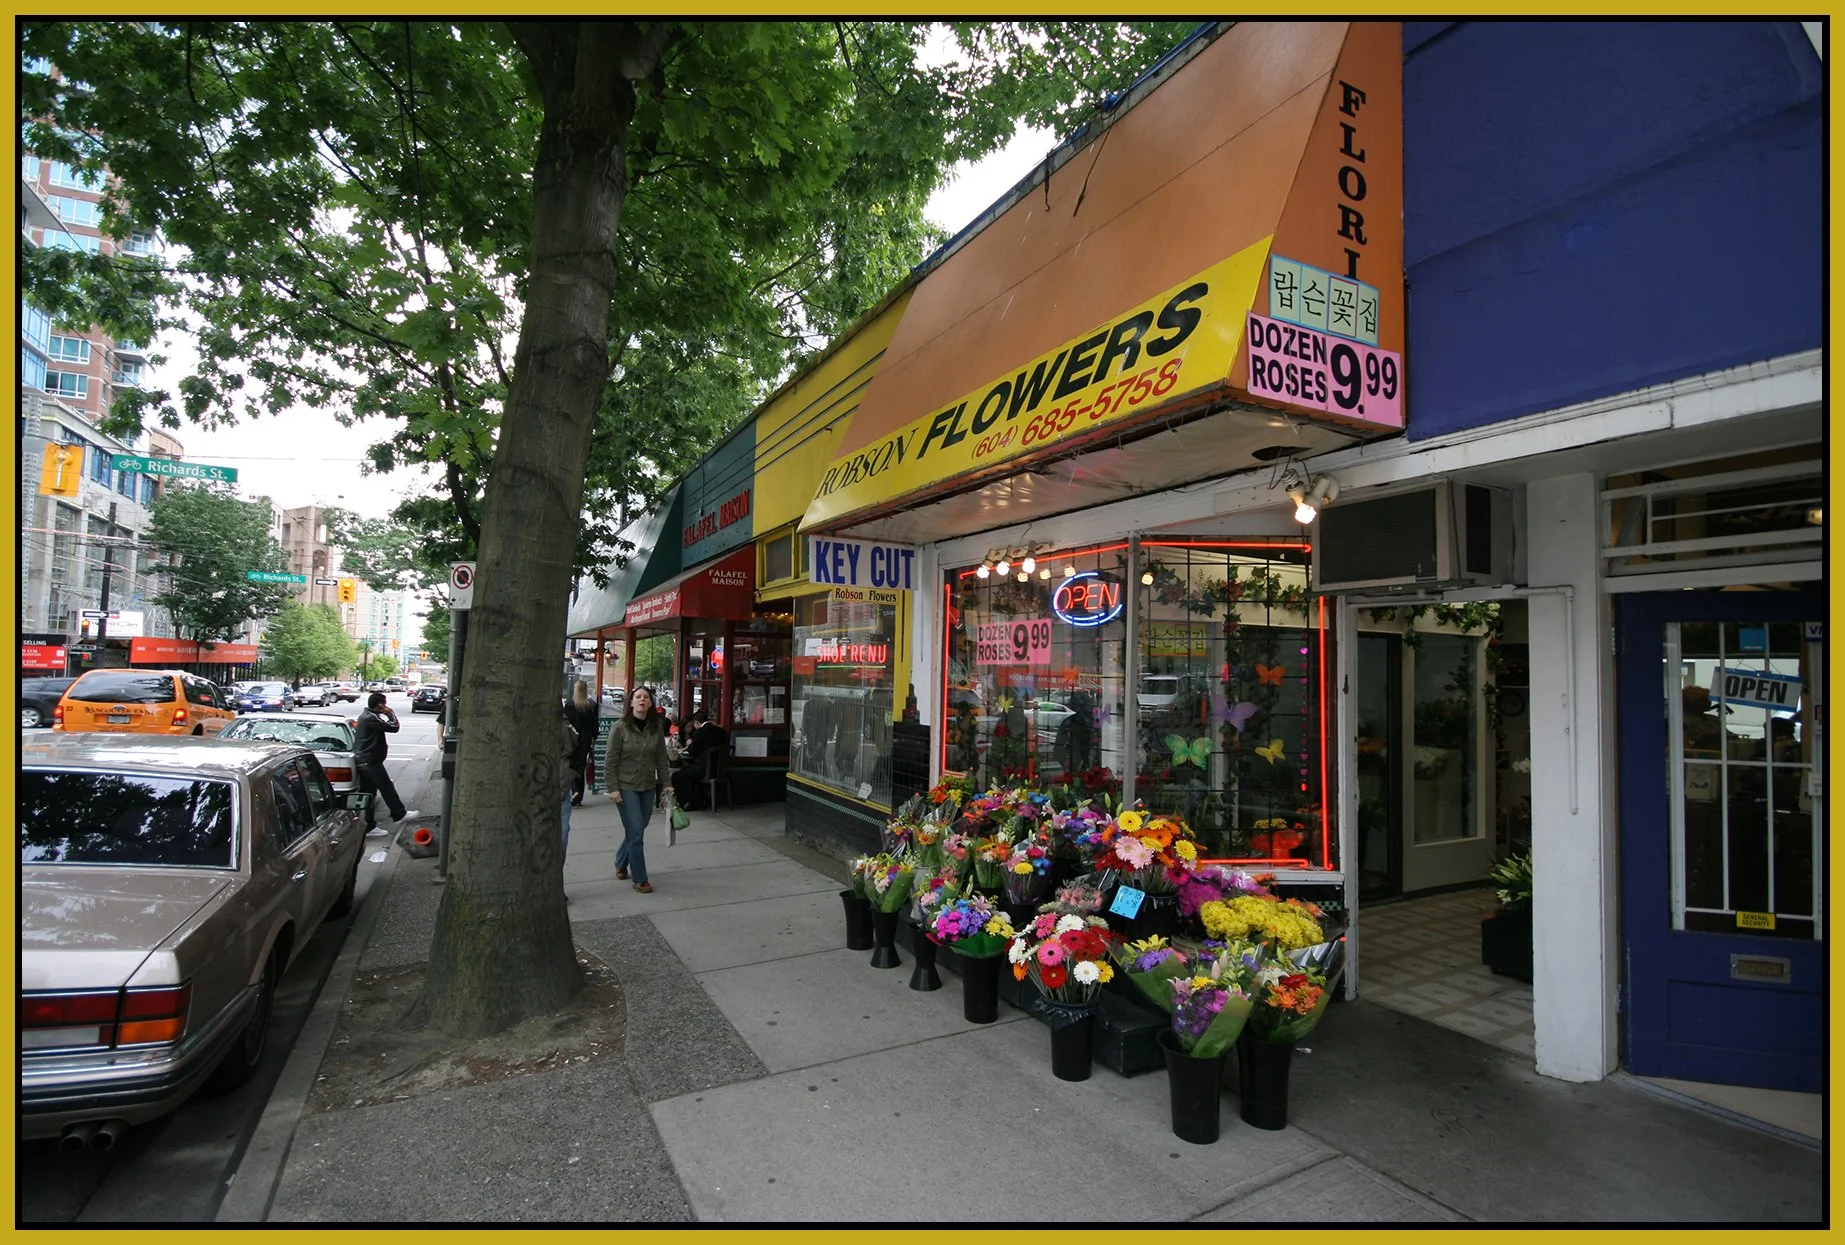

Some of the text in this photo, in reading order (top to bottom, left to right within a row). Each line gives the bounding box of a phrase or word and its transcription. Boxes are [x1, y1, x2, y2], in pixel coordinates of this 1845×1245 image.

[1250, 317, 1327, 365] DOZEN
[1252, 354, 1327, 403] ROSES
[815, 283, 1208, 500] ROBSON FLOWERS
[971, 358, 1182, 459] (604) 685-5758
[148, 460, 228, 479] Richards St.
[719, 489, 750, 530] MAISON
[709, 570, 748, 579] FALAFEL
[816, 541, 914, 589] KEY CUT
[263, 574, 291, 582] Richards
[712, 578, 744, 586] MAISON
[835, 588, 896, 603] Robson Flowers
[1056, 582, 1119, 612] OPEN
[979, 624, 1011, 641] DOZEN
[817, 644, 887, 663] SHOE RENU
[979, 643, 1011, 661] ROSES
[1725, 675, 1788, 704] OPEN
